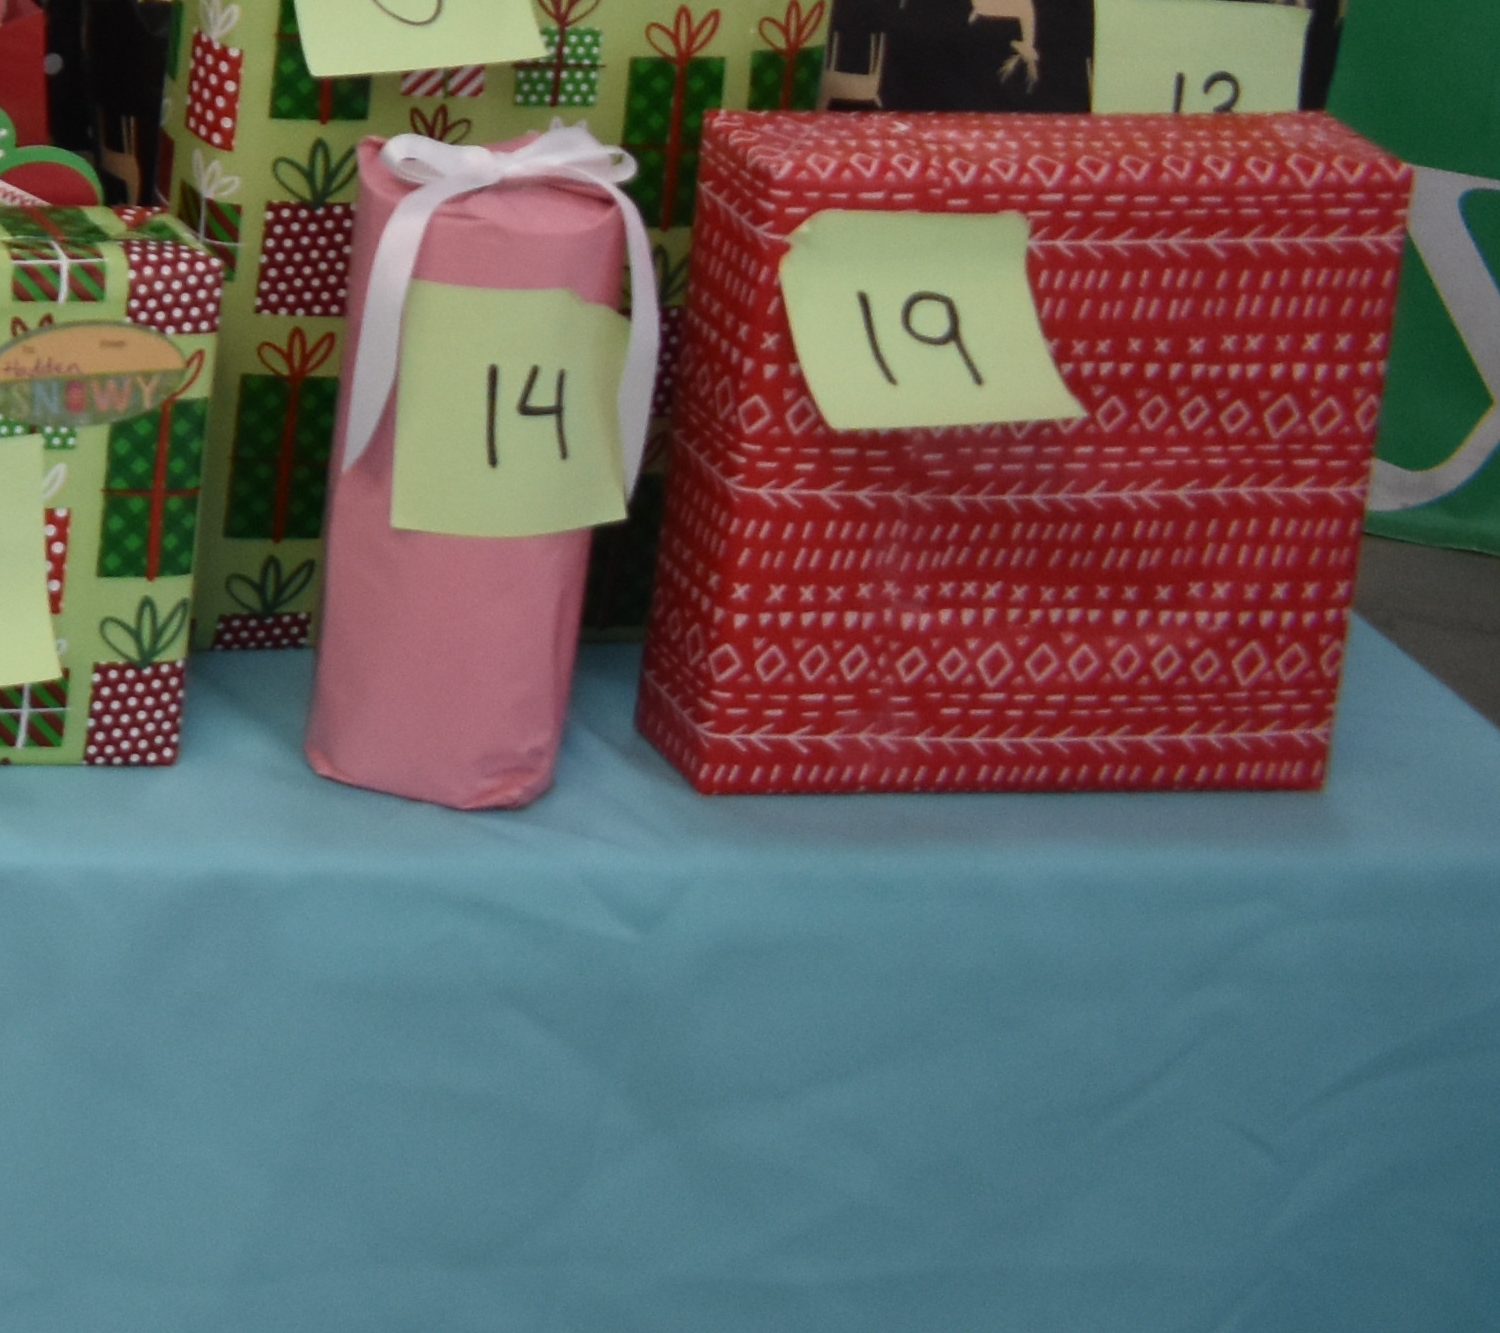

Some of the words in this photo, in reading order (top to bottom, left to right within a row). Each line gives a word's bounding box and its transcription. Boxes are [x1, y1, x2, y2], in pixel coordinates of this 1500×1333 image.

[857, 290, 985, 387] 19
[11, 375, 161, 420] SNOWY
[486, 363, 569, 469] 14
